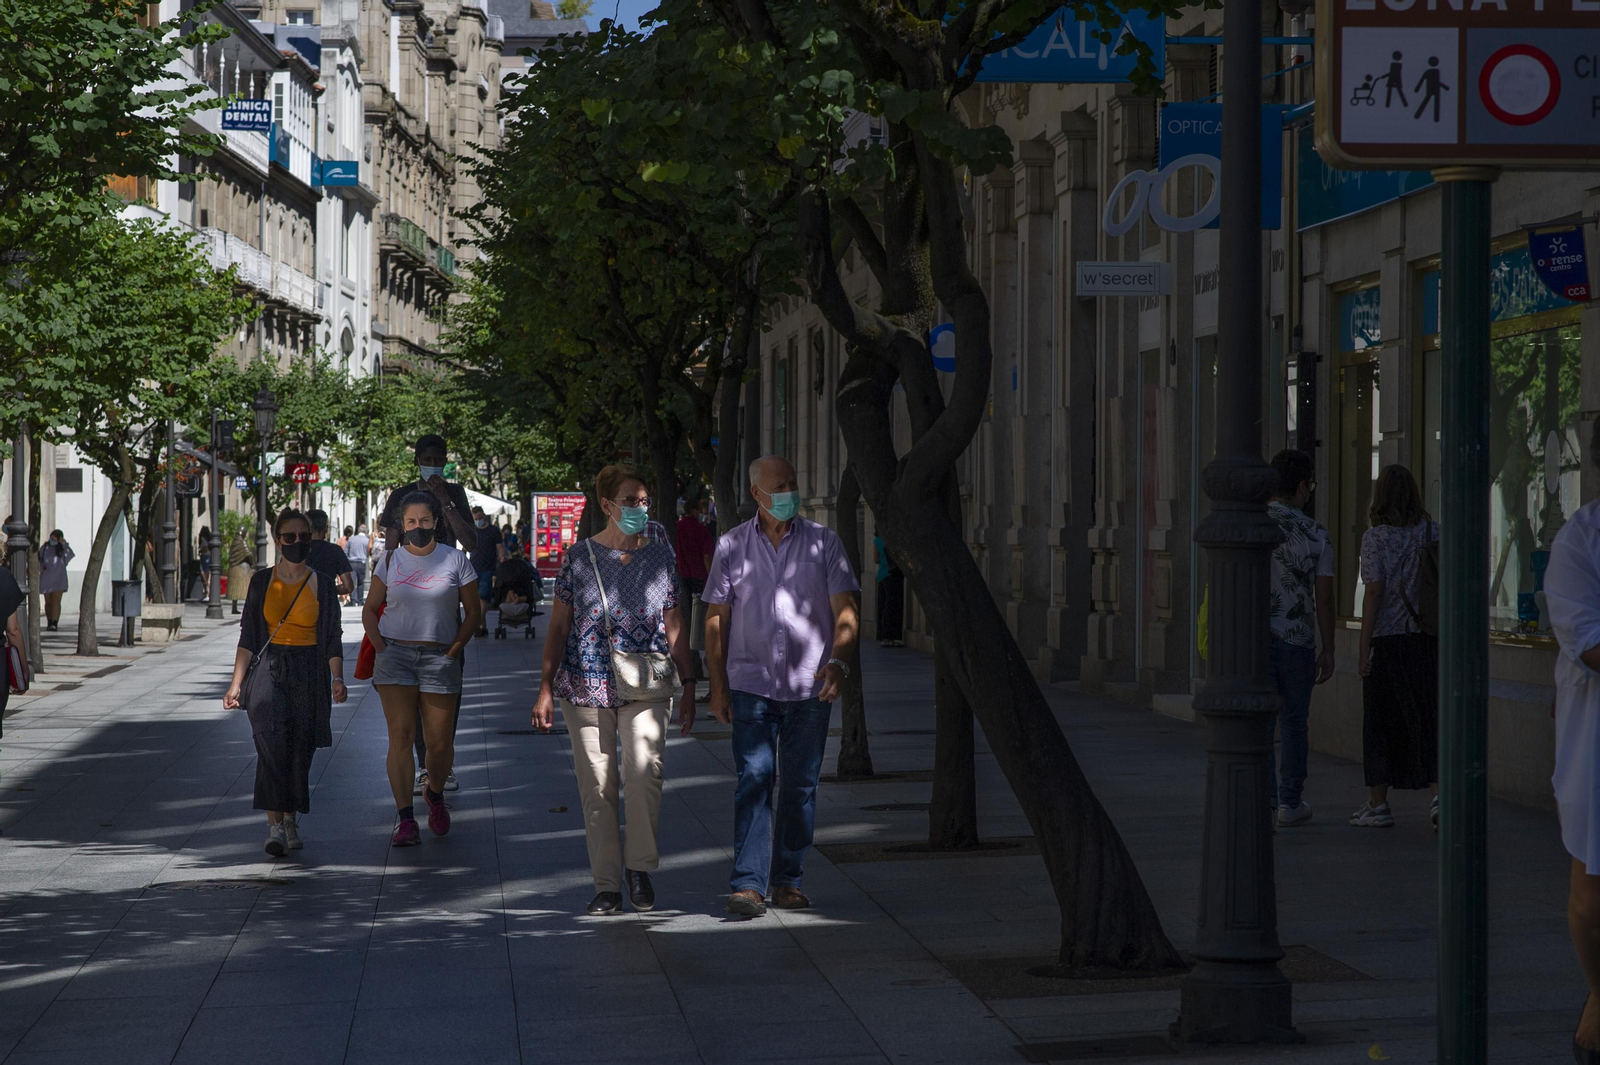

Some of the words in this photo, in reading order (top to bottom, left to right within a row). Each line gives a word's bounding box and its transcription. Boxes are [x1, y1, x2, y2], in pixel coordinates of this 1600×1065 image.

[225, 111, 269, 122] DENTAL
[1550, 264, 1572, 272] centro
[1083, 272, 1154, 289] w'secret
[1568, 286, 1587, 297] cca
